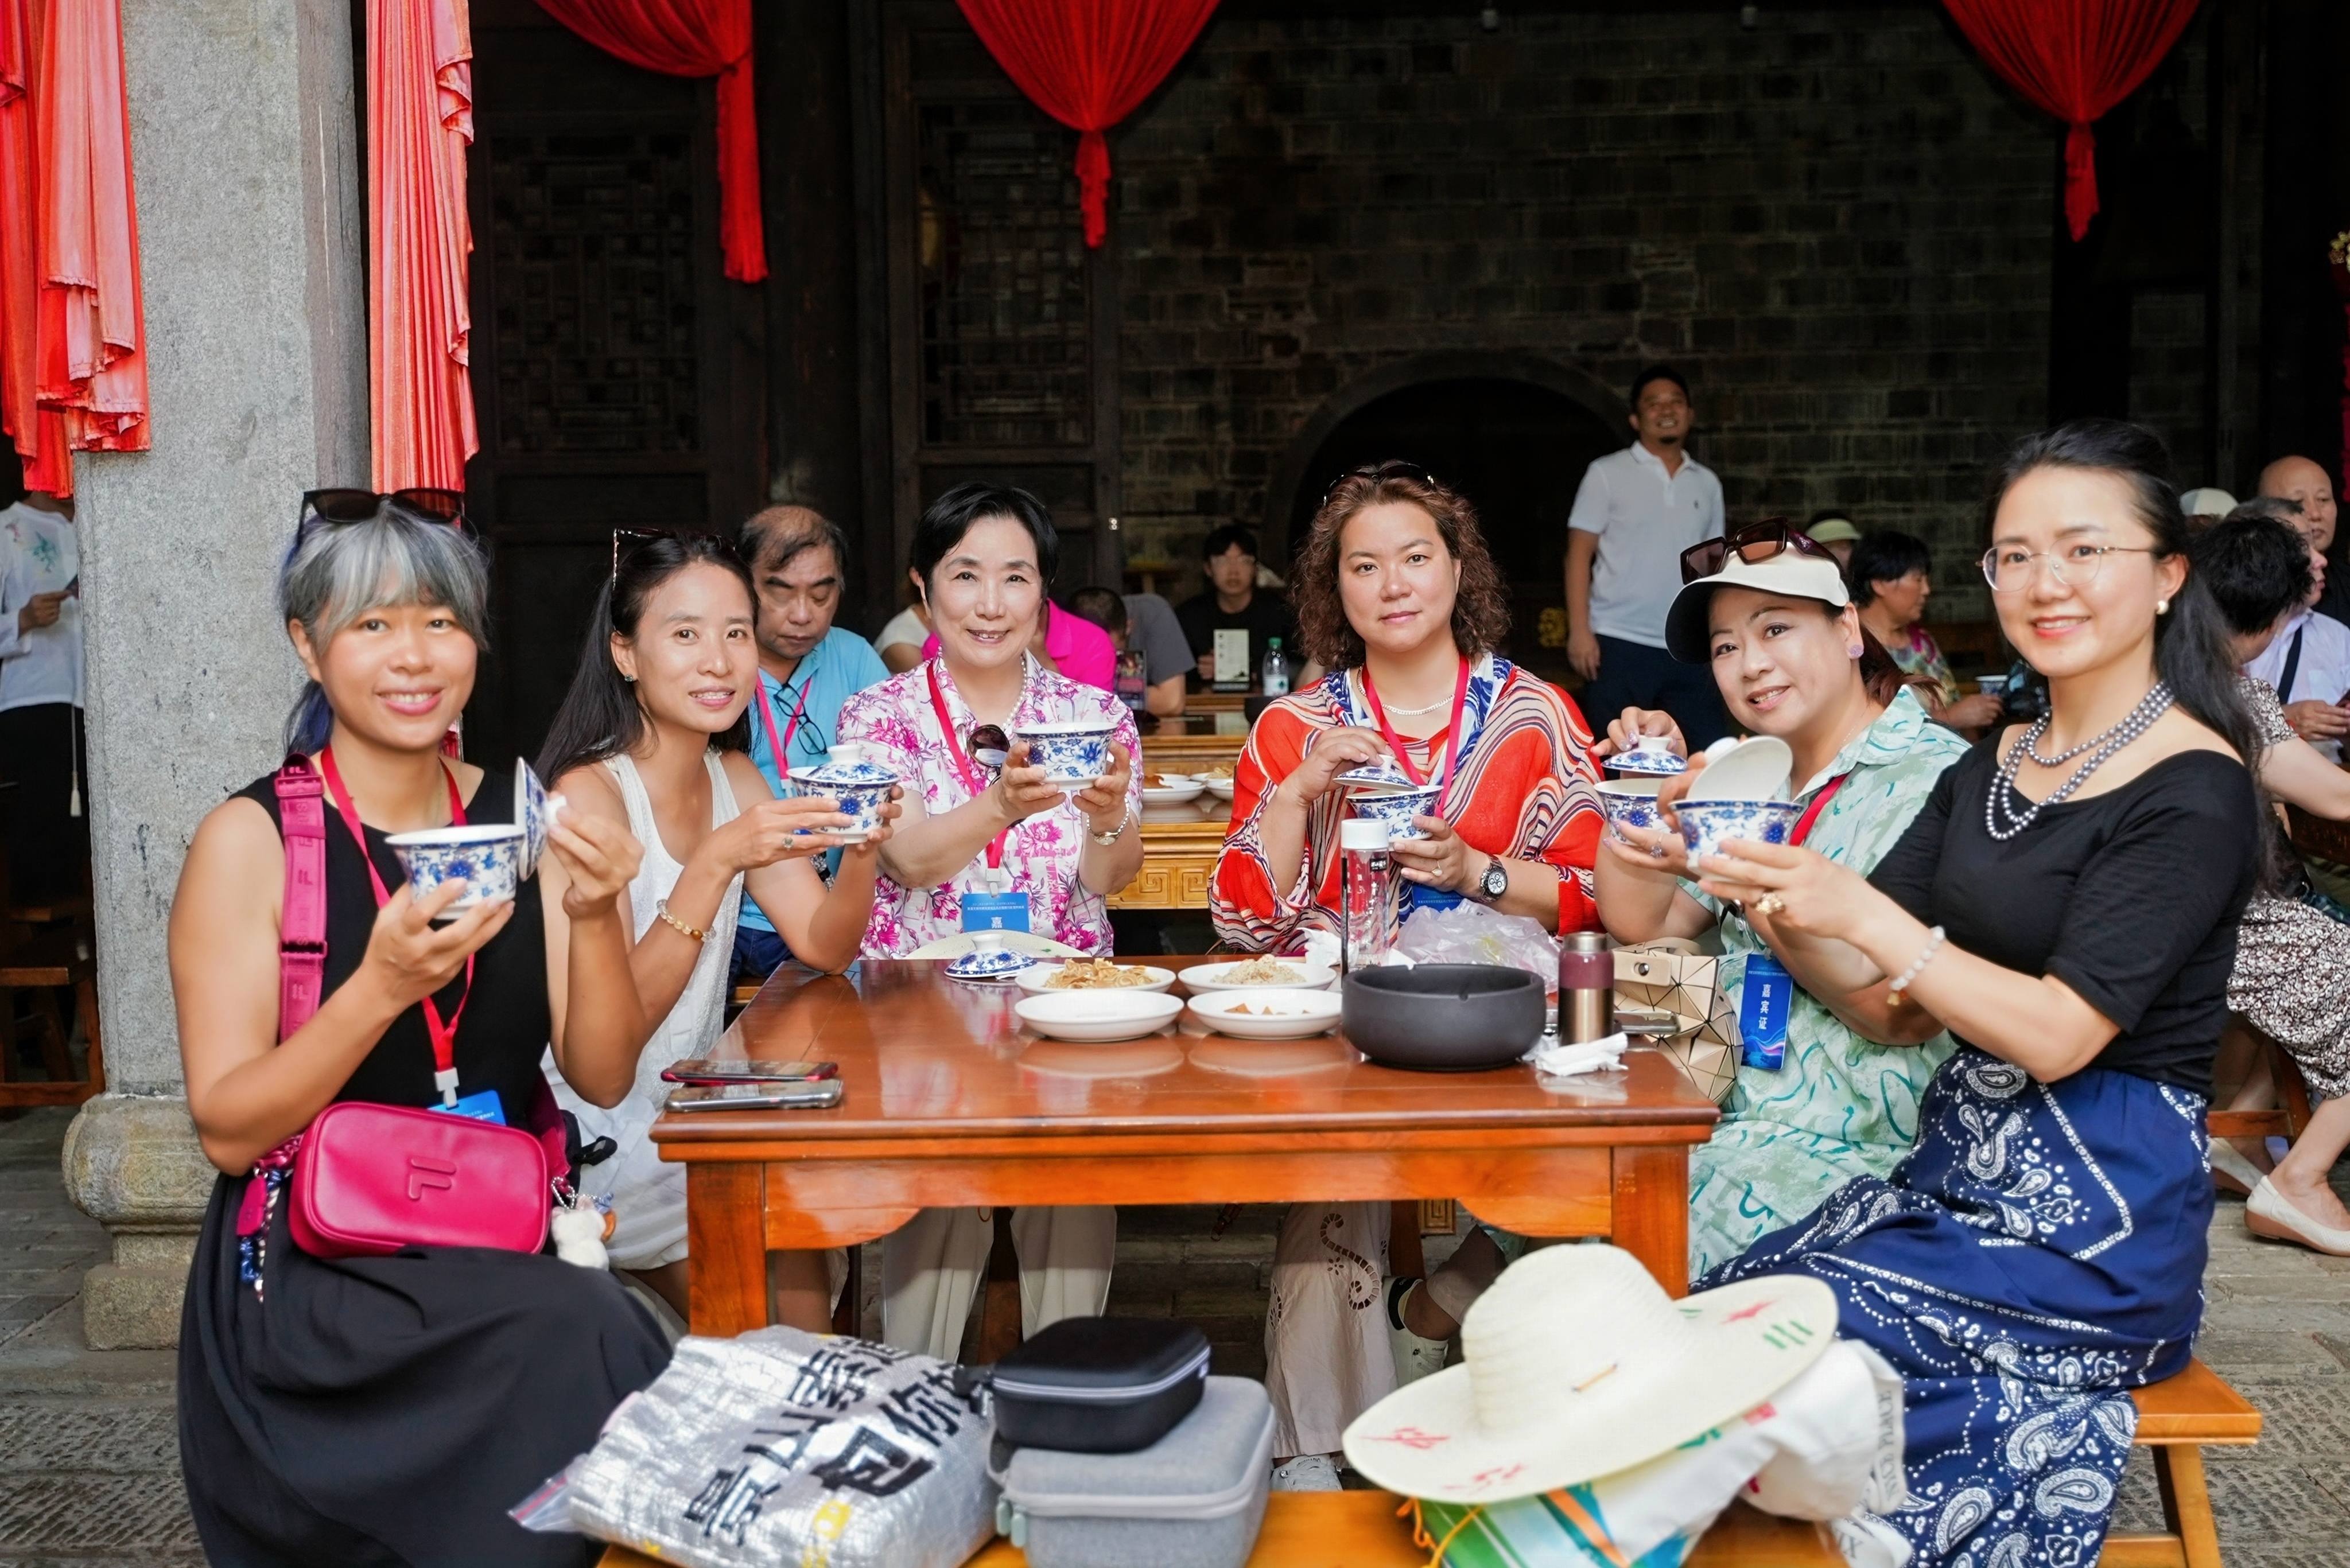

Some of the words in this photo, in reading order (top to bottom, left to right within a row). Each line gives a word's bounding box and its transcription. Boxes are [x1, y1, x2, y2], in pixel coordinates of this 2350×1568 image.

[991, 916, 1003, 928] 嘉
[1758, 984, 1771, 1030] 嘉宾证
[1878, 1390, 1893, 1450] PLACE
[1879, 1453, 1899, 1501] NICE
